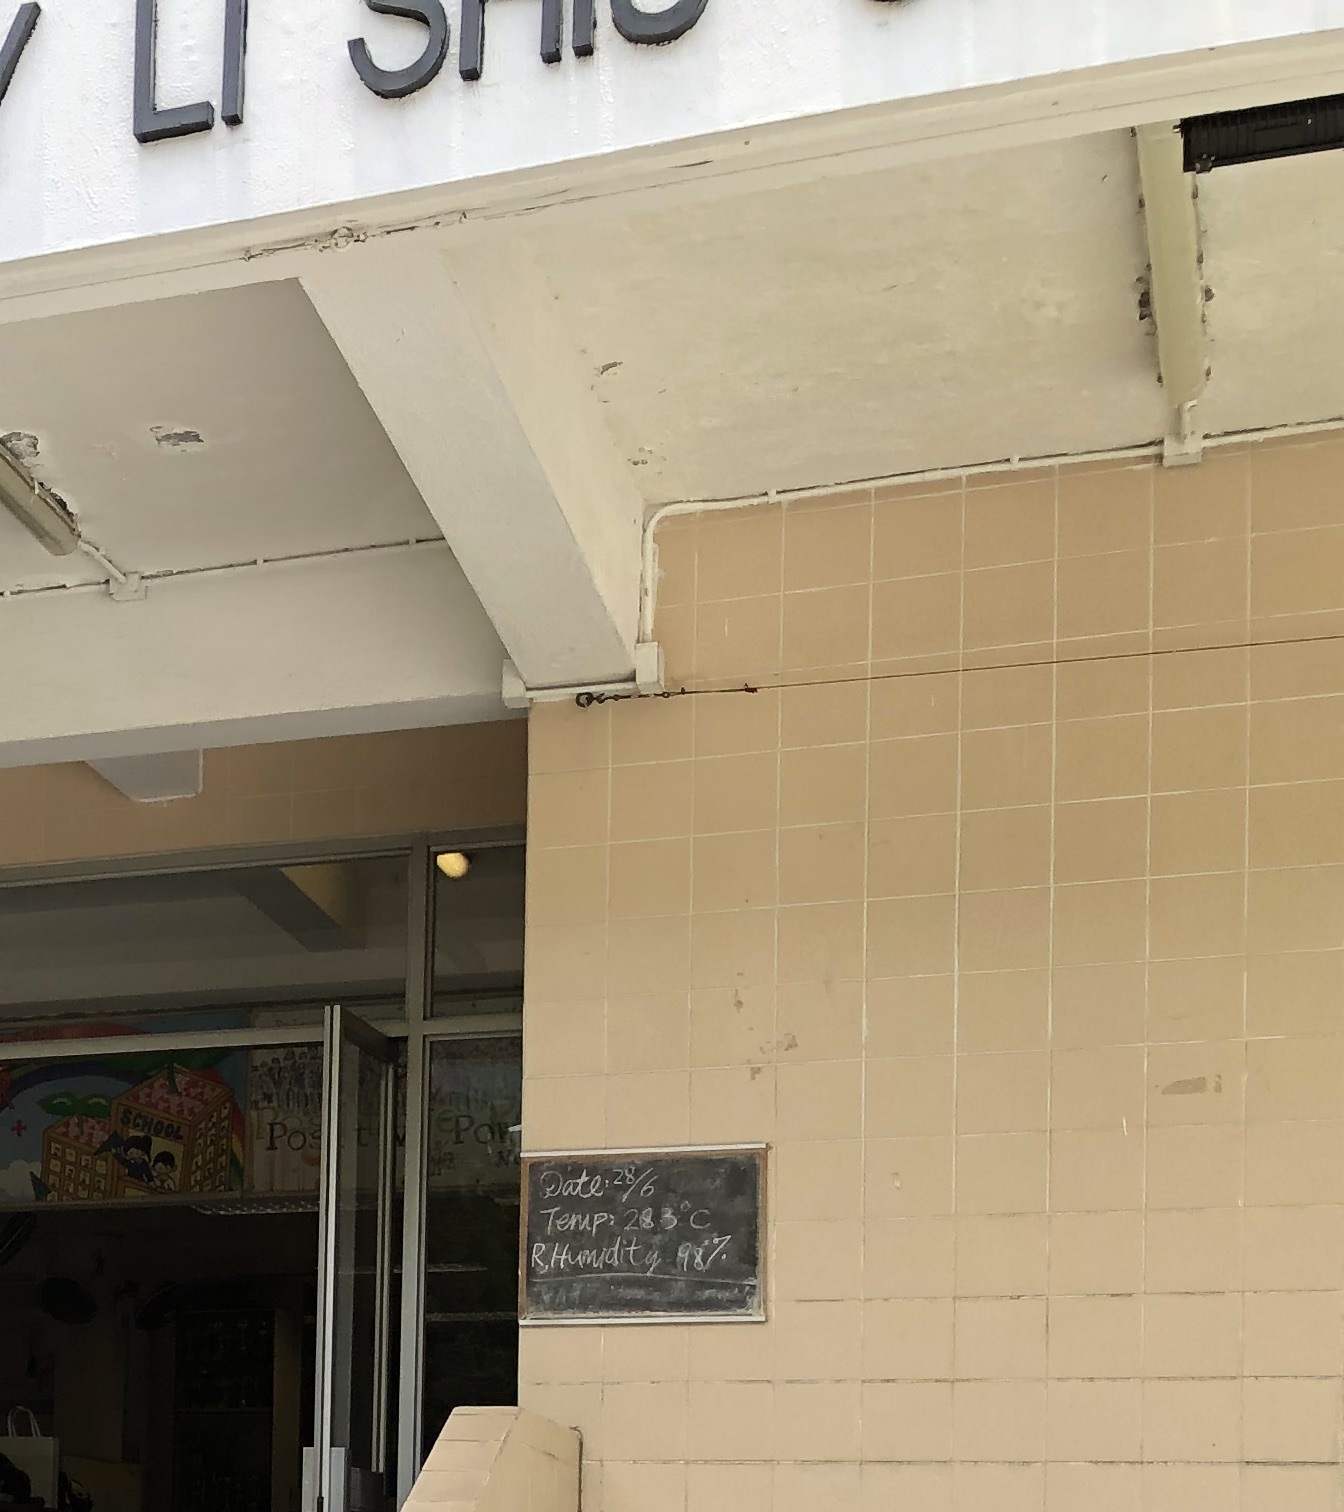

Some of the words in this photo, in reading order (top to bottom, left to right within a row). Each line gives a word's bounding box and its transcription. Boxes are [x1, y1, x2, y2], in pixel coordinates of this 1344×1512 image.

[133, 0, 247, 142] LI
[120, 1108, 184, 1140] SCHOOL
[540, 1206, 615, 1237] Temp:
